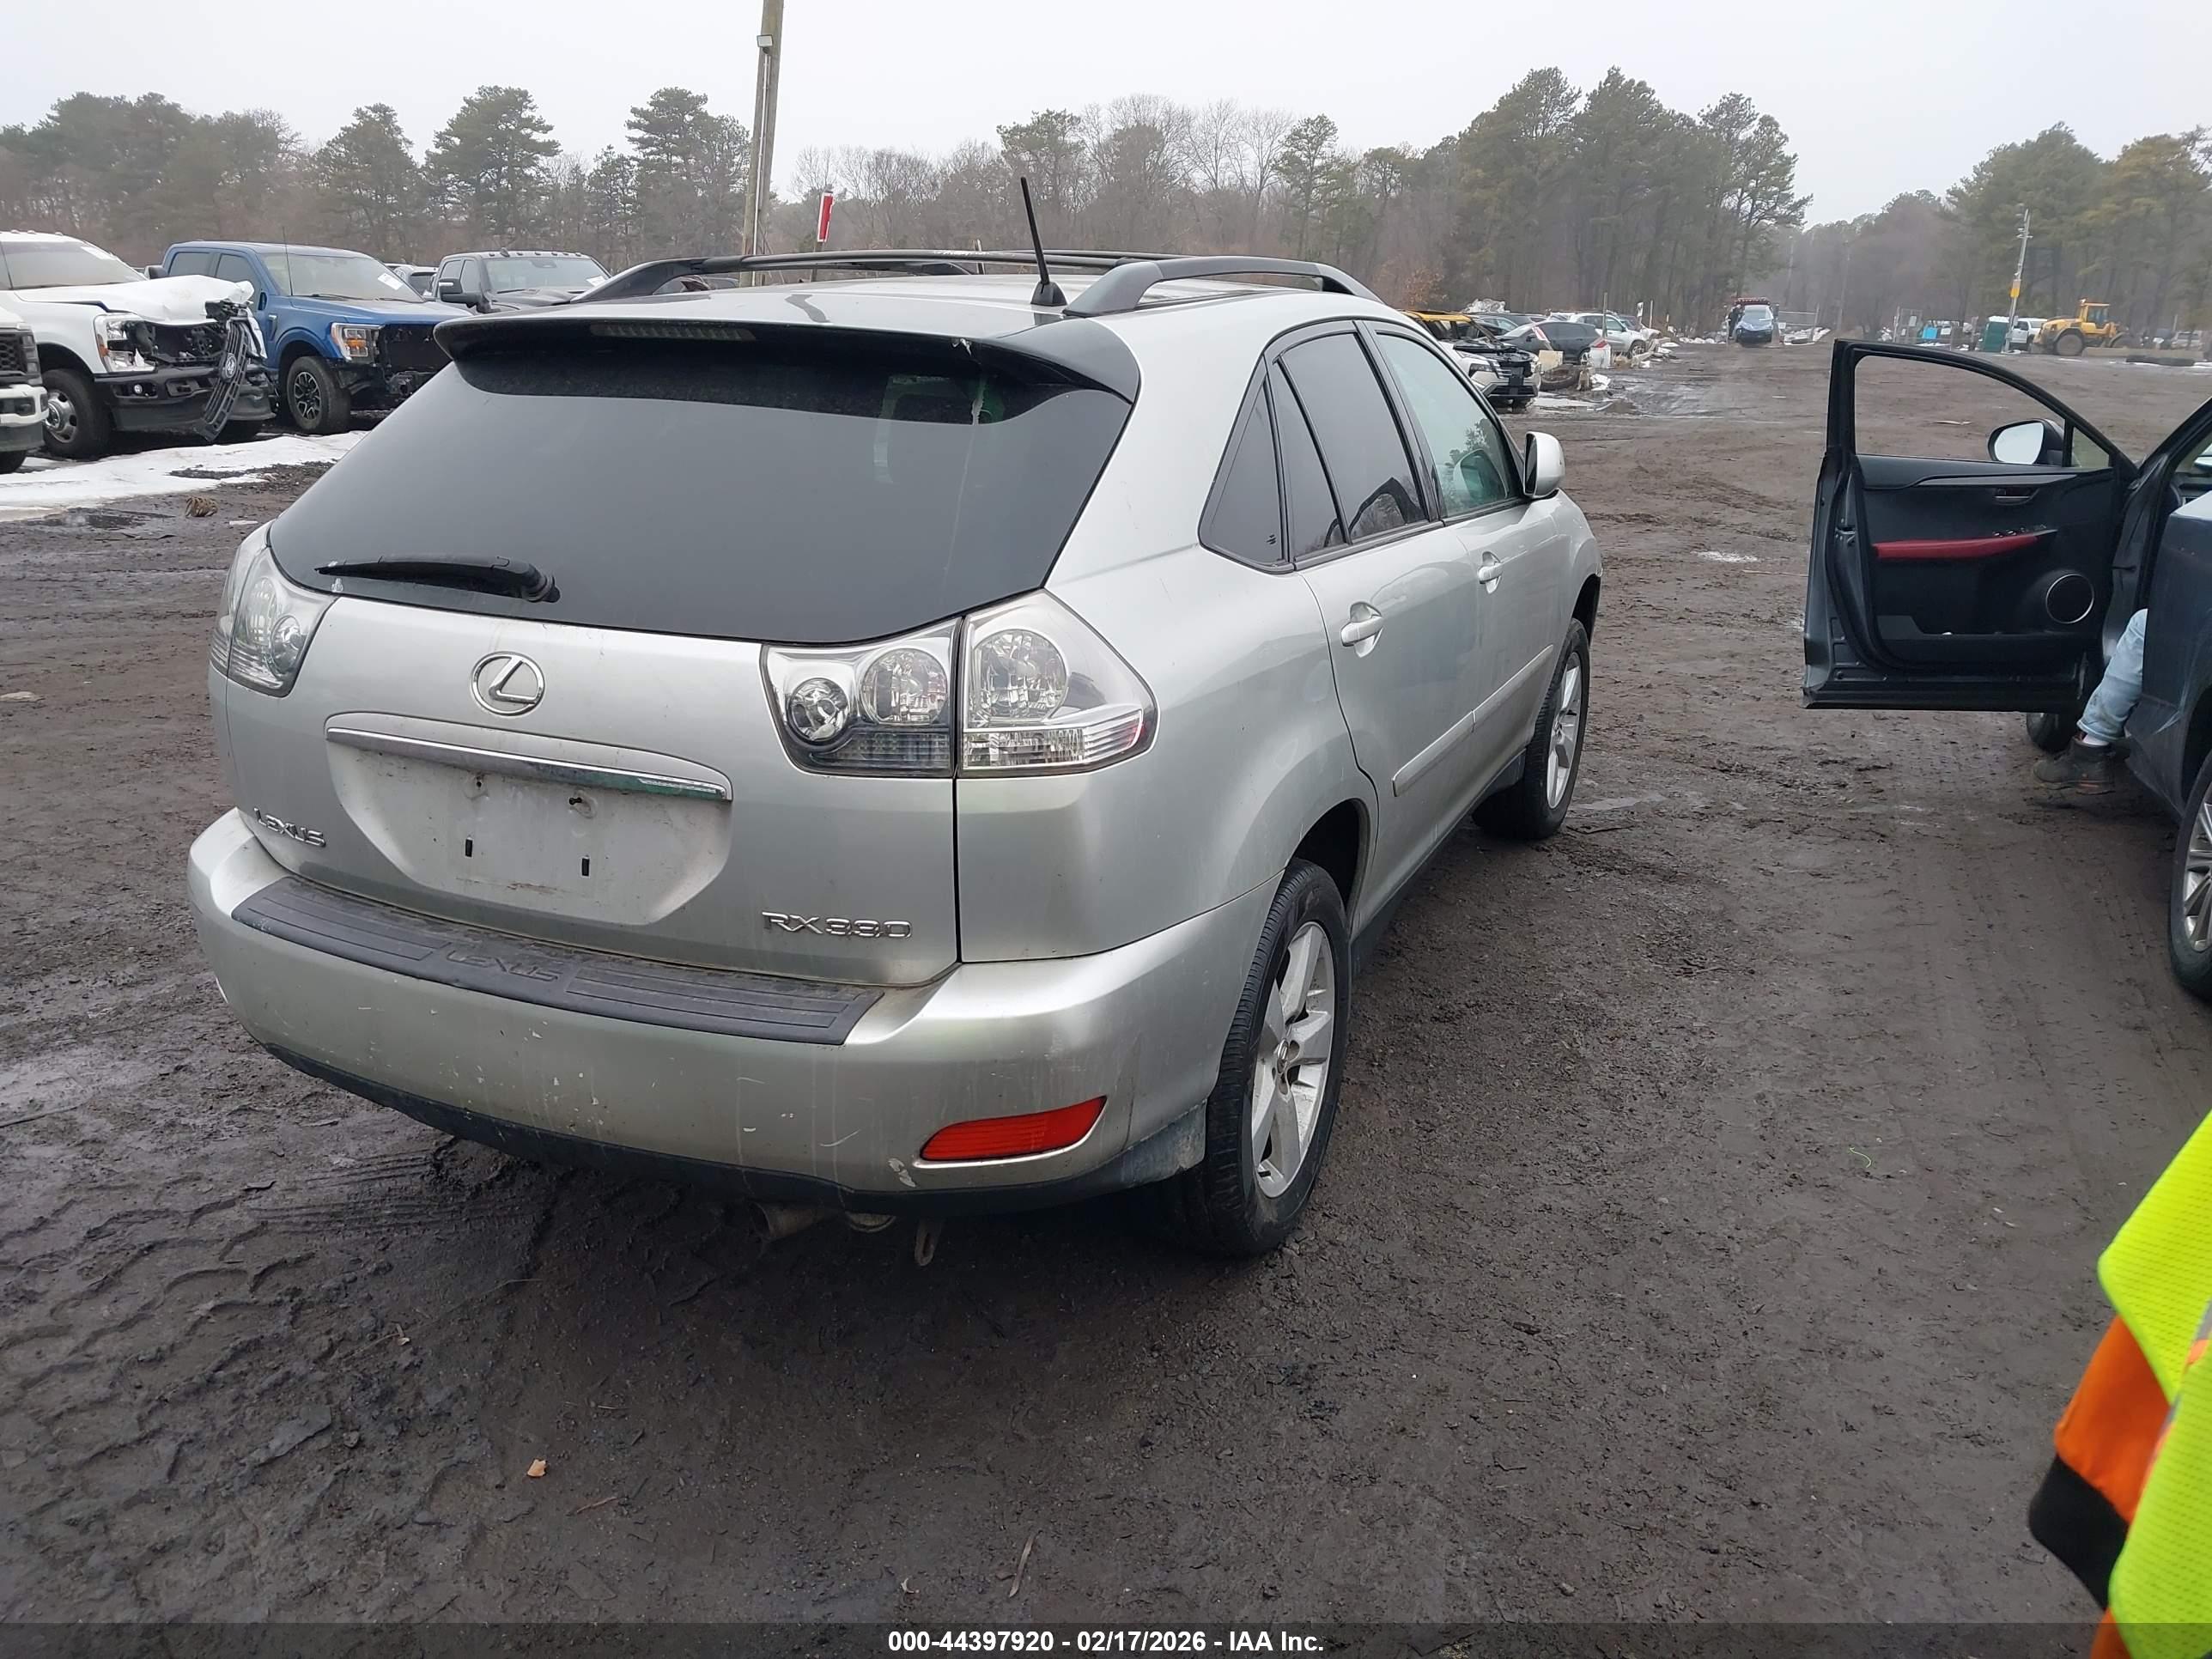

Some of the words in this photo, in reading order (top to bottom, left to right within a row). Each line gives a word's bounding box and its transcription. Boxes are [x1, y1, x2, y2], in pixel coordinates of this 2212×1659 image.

[253, 807, 326, 848] LEXUS
[761, 910, 913, 939] RX330
[446, 949, 563, 982] LEXUS
